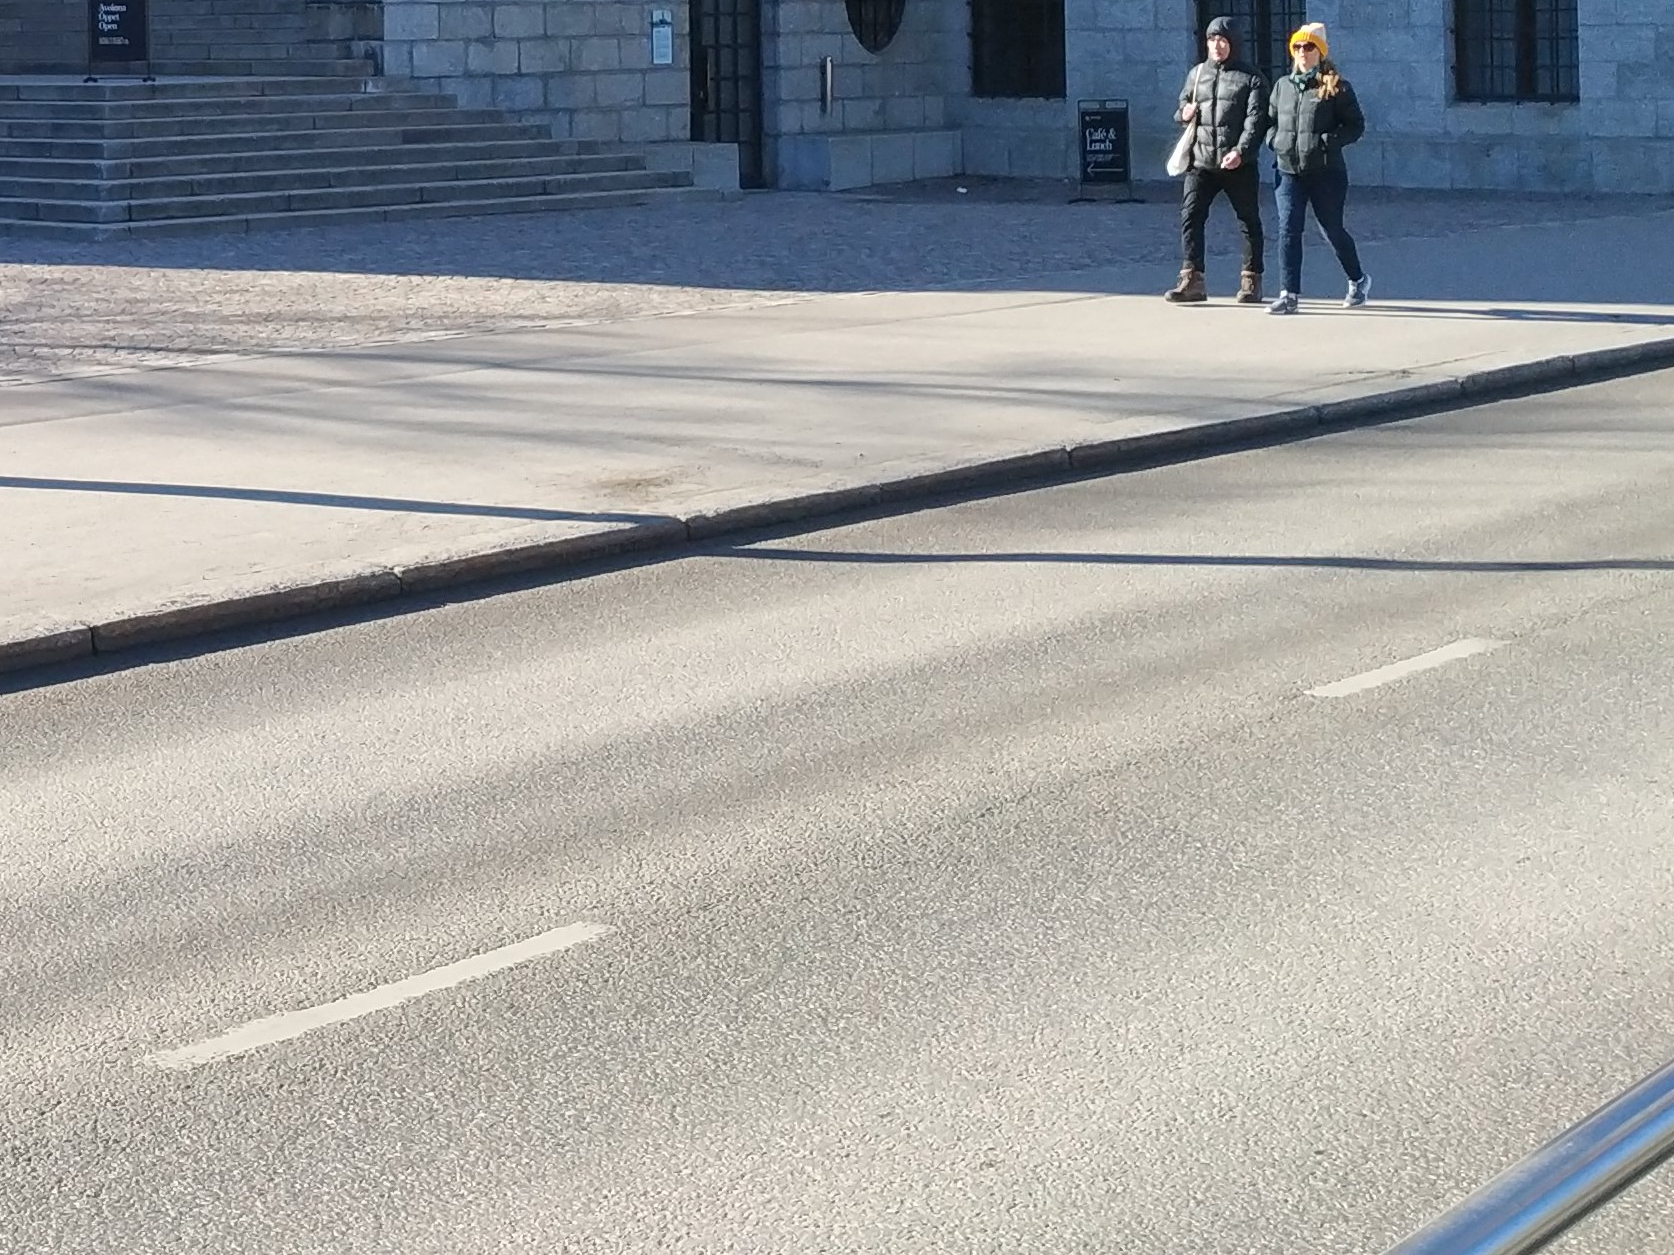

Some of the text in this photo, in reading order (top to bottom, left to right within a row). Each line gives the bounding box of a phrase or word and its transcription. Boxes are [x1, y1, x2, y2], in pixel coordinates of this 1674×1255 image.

[98, 22, 118, 32] Open
[1086, 128, 1117, 140] Café &
[1086, 139, 1113, 151] Lunch
